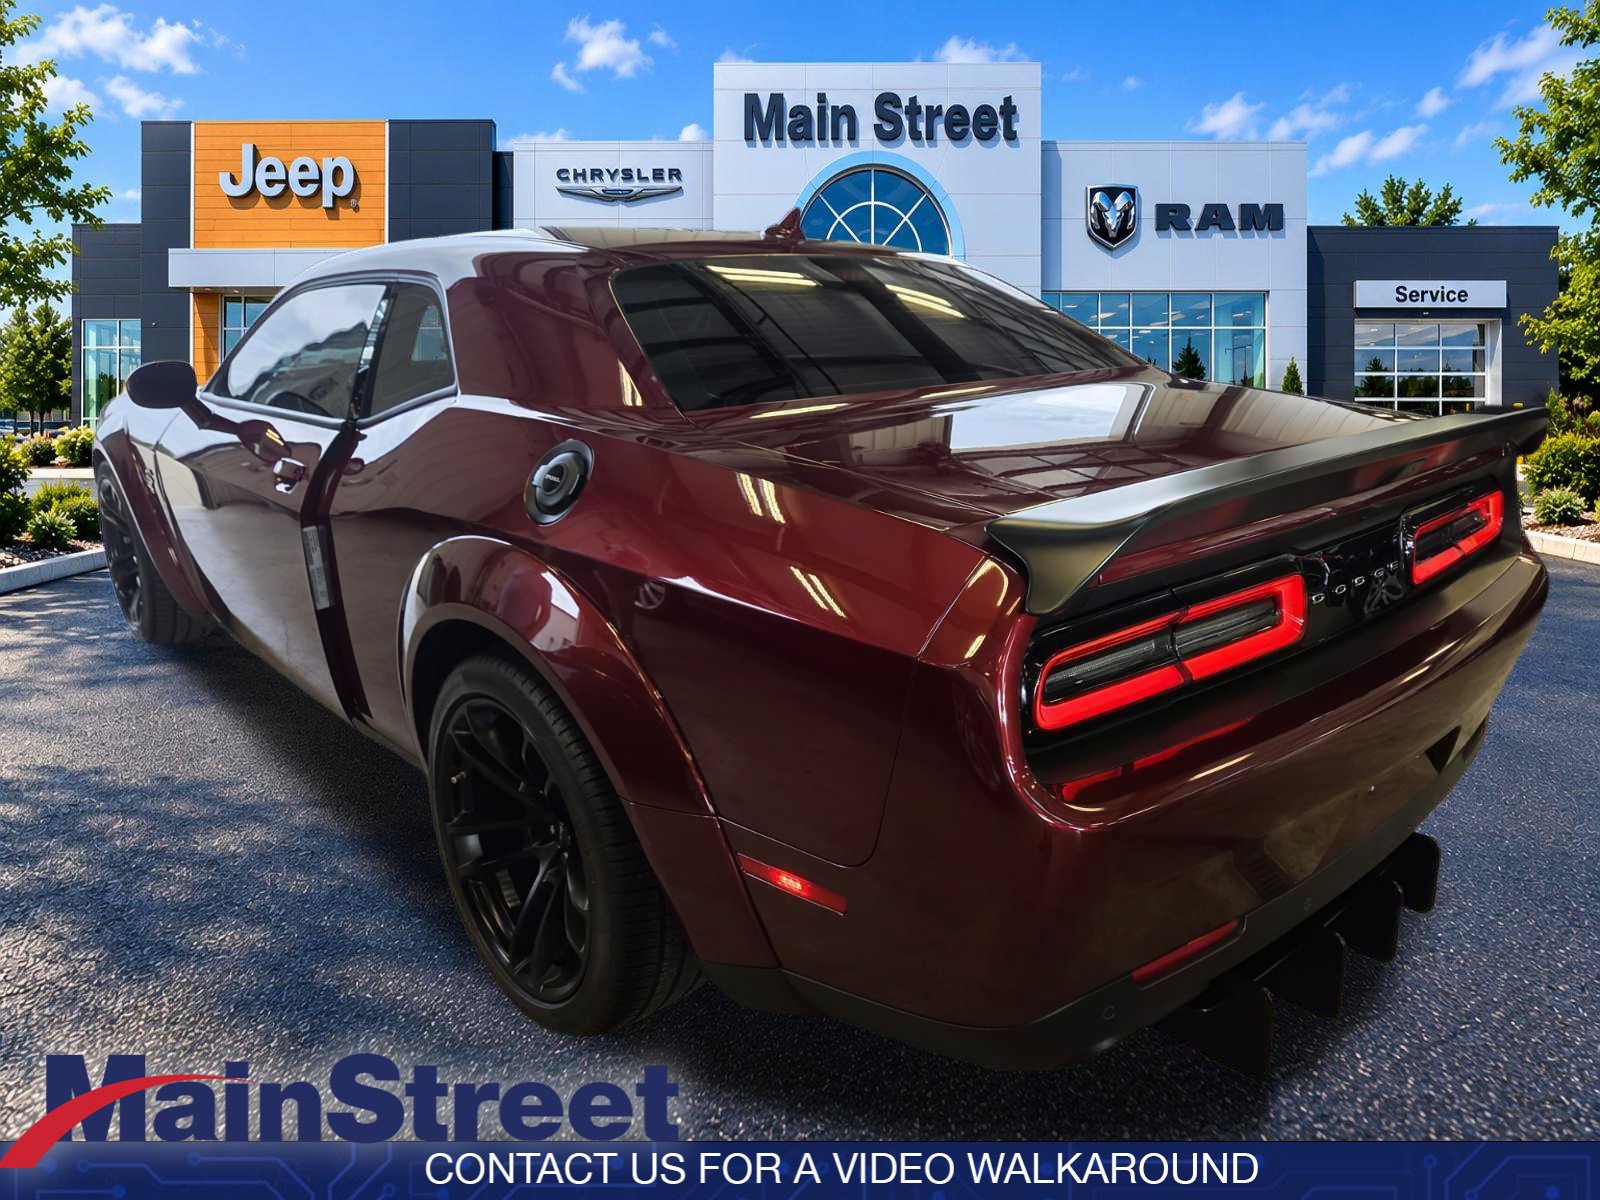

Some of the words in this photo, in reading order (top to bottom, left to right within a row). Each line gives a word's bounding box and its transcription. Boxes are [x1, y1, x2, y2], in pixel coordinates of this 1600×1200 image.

[743, 92, 857, 141] Main
[873, 91, 1018, 141] Street
[218, 143, 355, 208] Jeep
[556, 167, 682, 183] CHRYSLER
[1154, 203, 1284, 232] RAM
[1394, 285, 1469, 303] Service
[1310, 560, 1399, 605] DODGE
